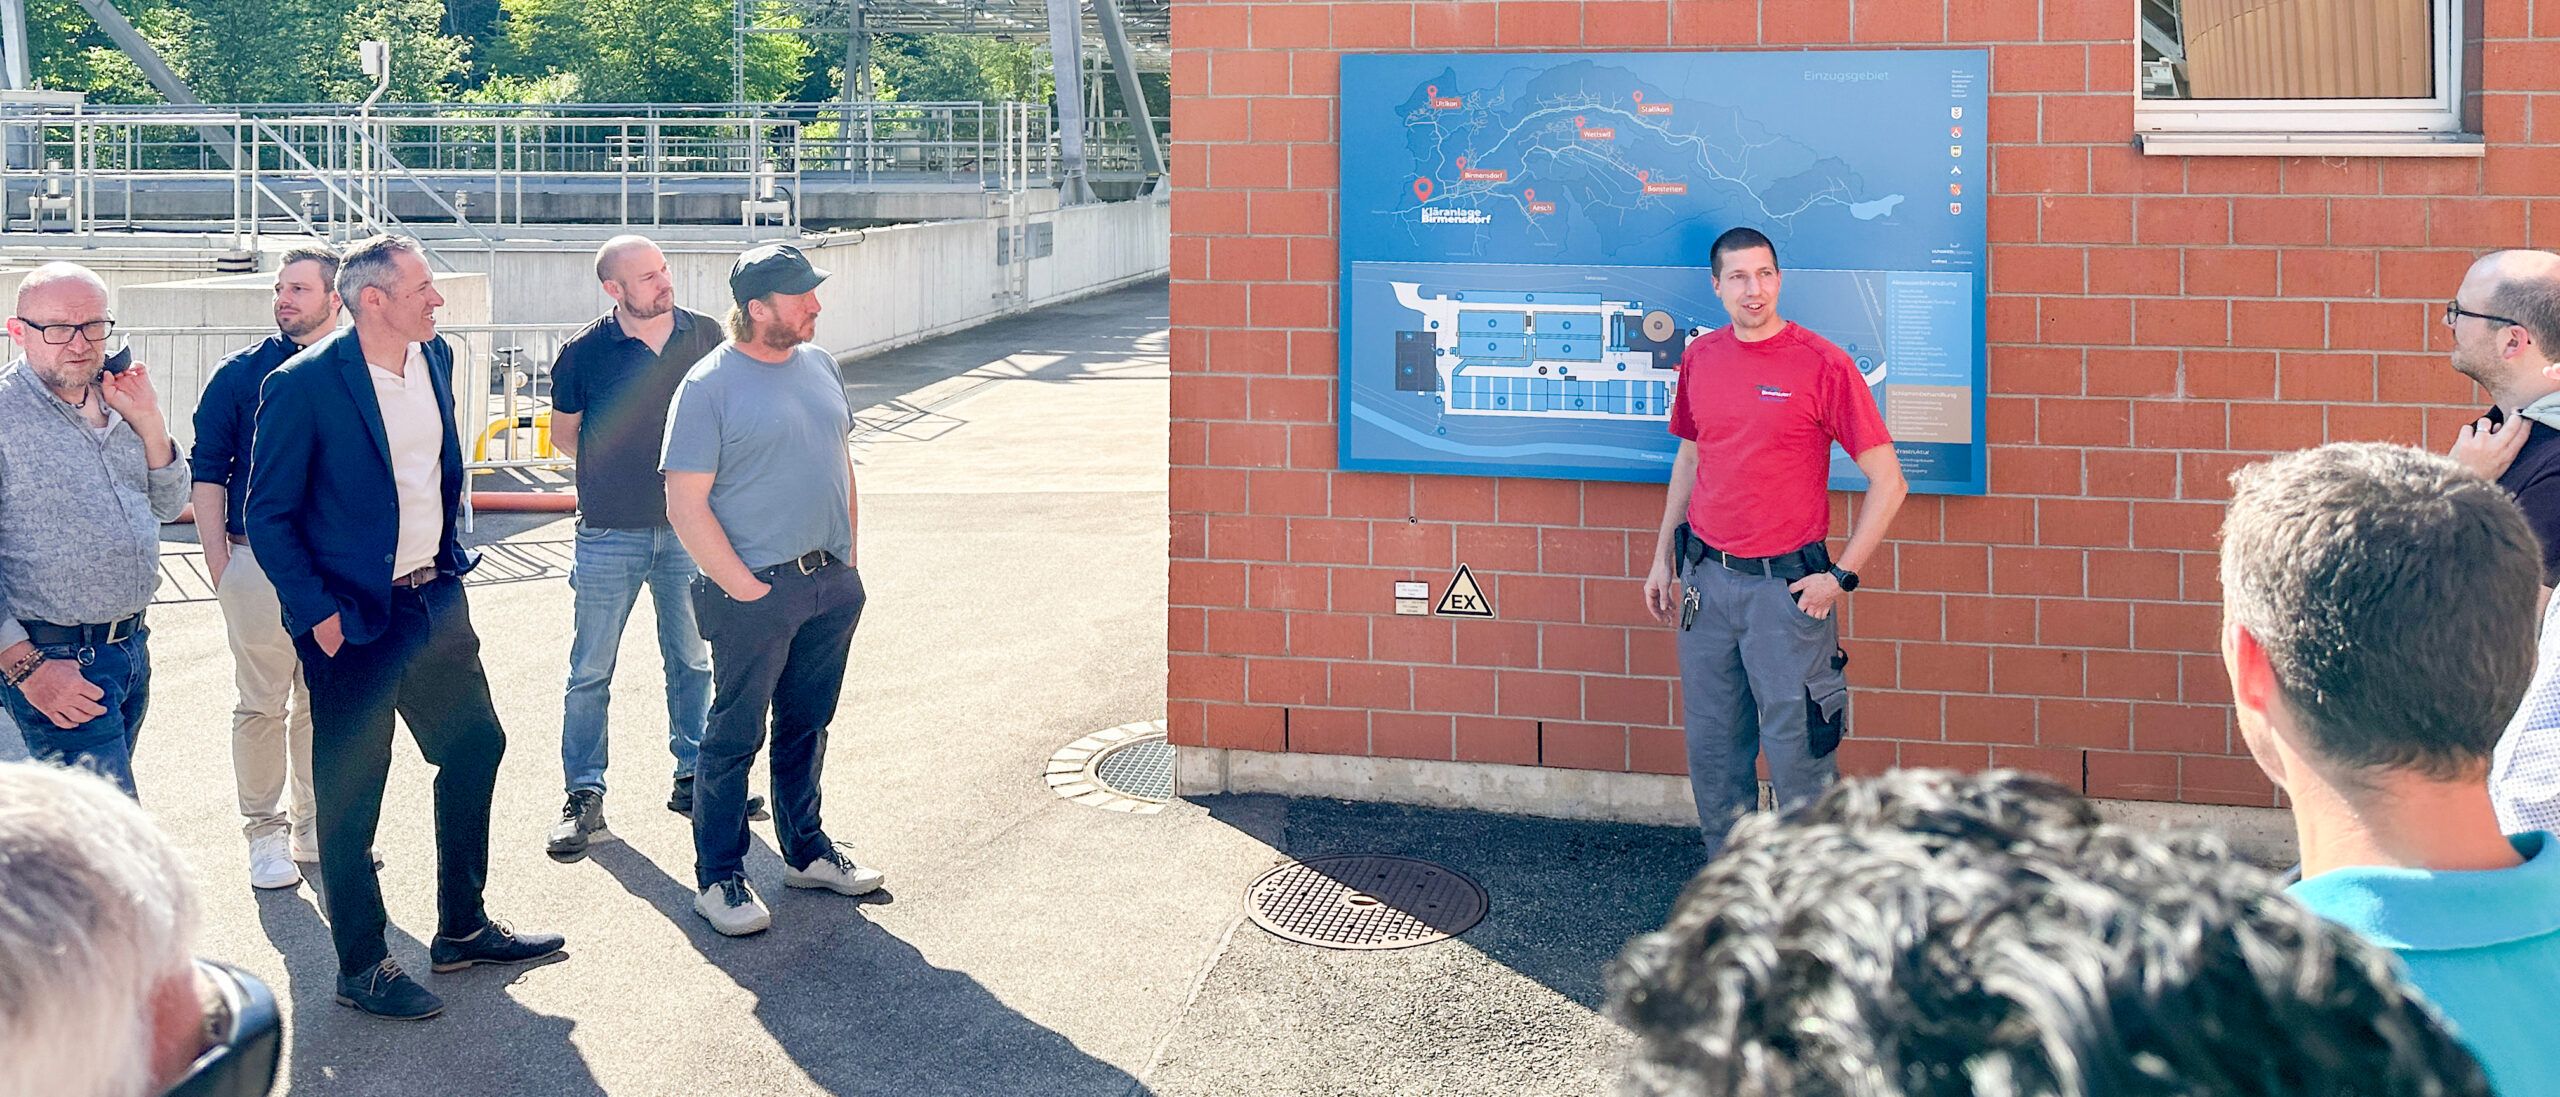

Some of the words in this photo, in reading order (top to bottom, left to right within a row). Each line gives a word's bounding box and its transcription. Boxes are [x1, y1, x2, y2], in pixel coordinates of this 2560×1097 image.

[1804, 71, 1889, 82] Einzugsgebiet
[1421, 207, 1482, 218] Kläranlage
[1421, 214, 1492, 224] Birmensdorf
[1451, 594, 1477, 610] EX
